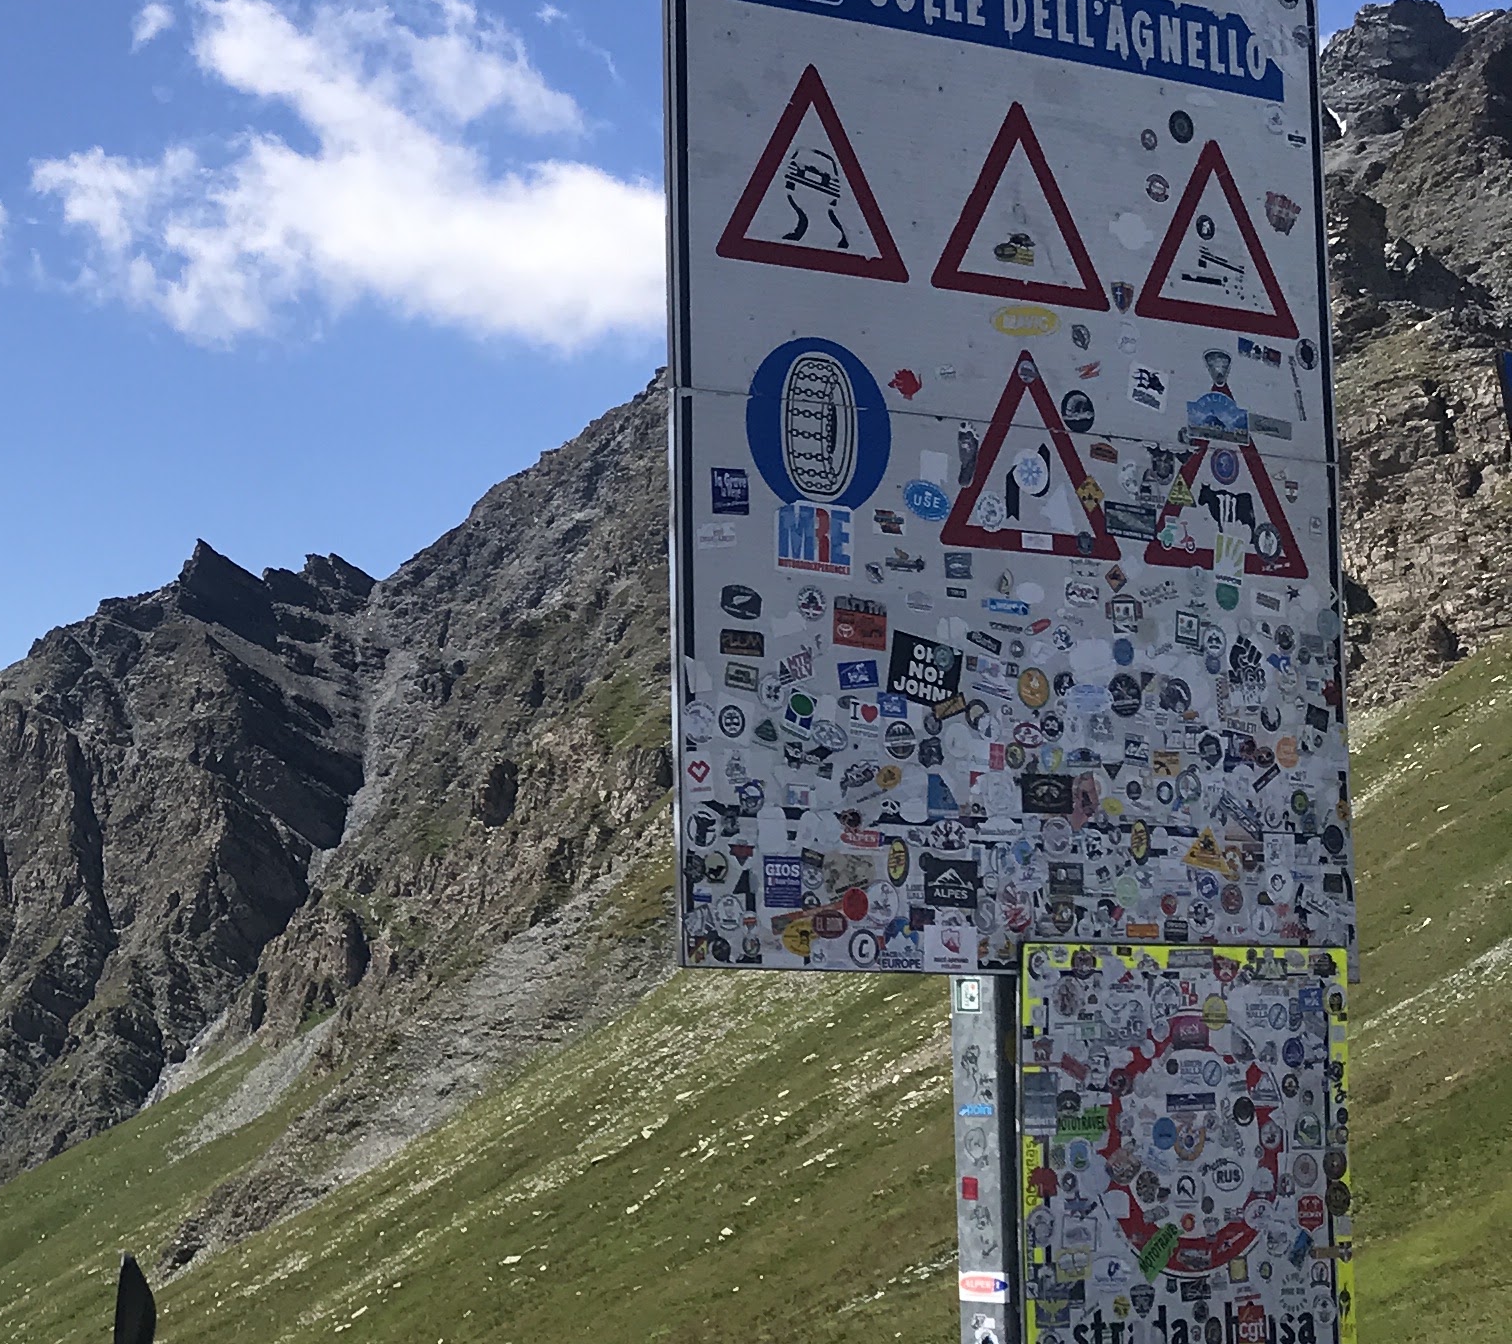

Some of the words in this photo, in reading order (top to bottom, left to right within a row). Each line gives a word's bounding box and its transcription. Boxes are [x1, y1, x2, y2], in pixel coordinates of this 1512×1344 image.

[913, 493, 941, 508] USE
[908, 660, 945, 686] NO!
[765, 863, 800, 877] GIOS
[933, 888, 969, 901] ALPES
[882, 958, 921, 969] EUROPE
[1216, 1169, 1241, 1184] RUS
[1239, 1318, 1265, 1342] cgt
